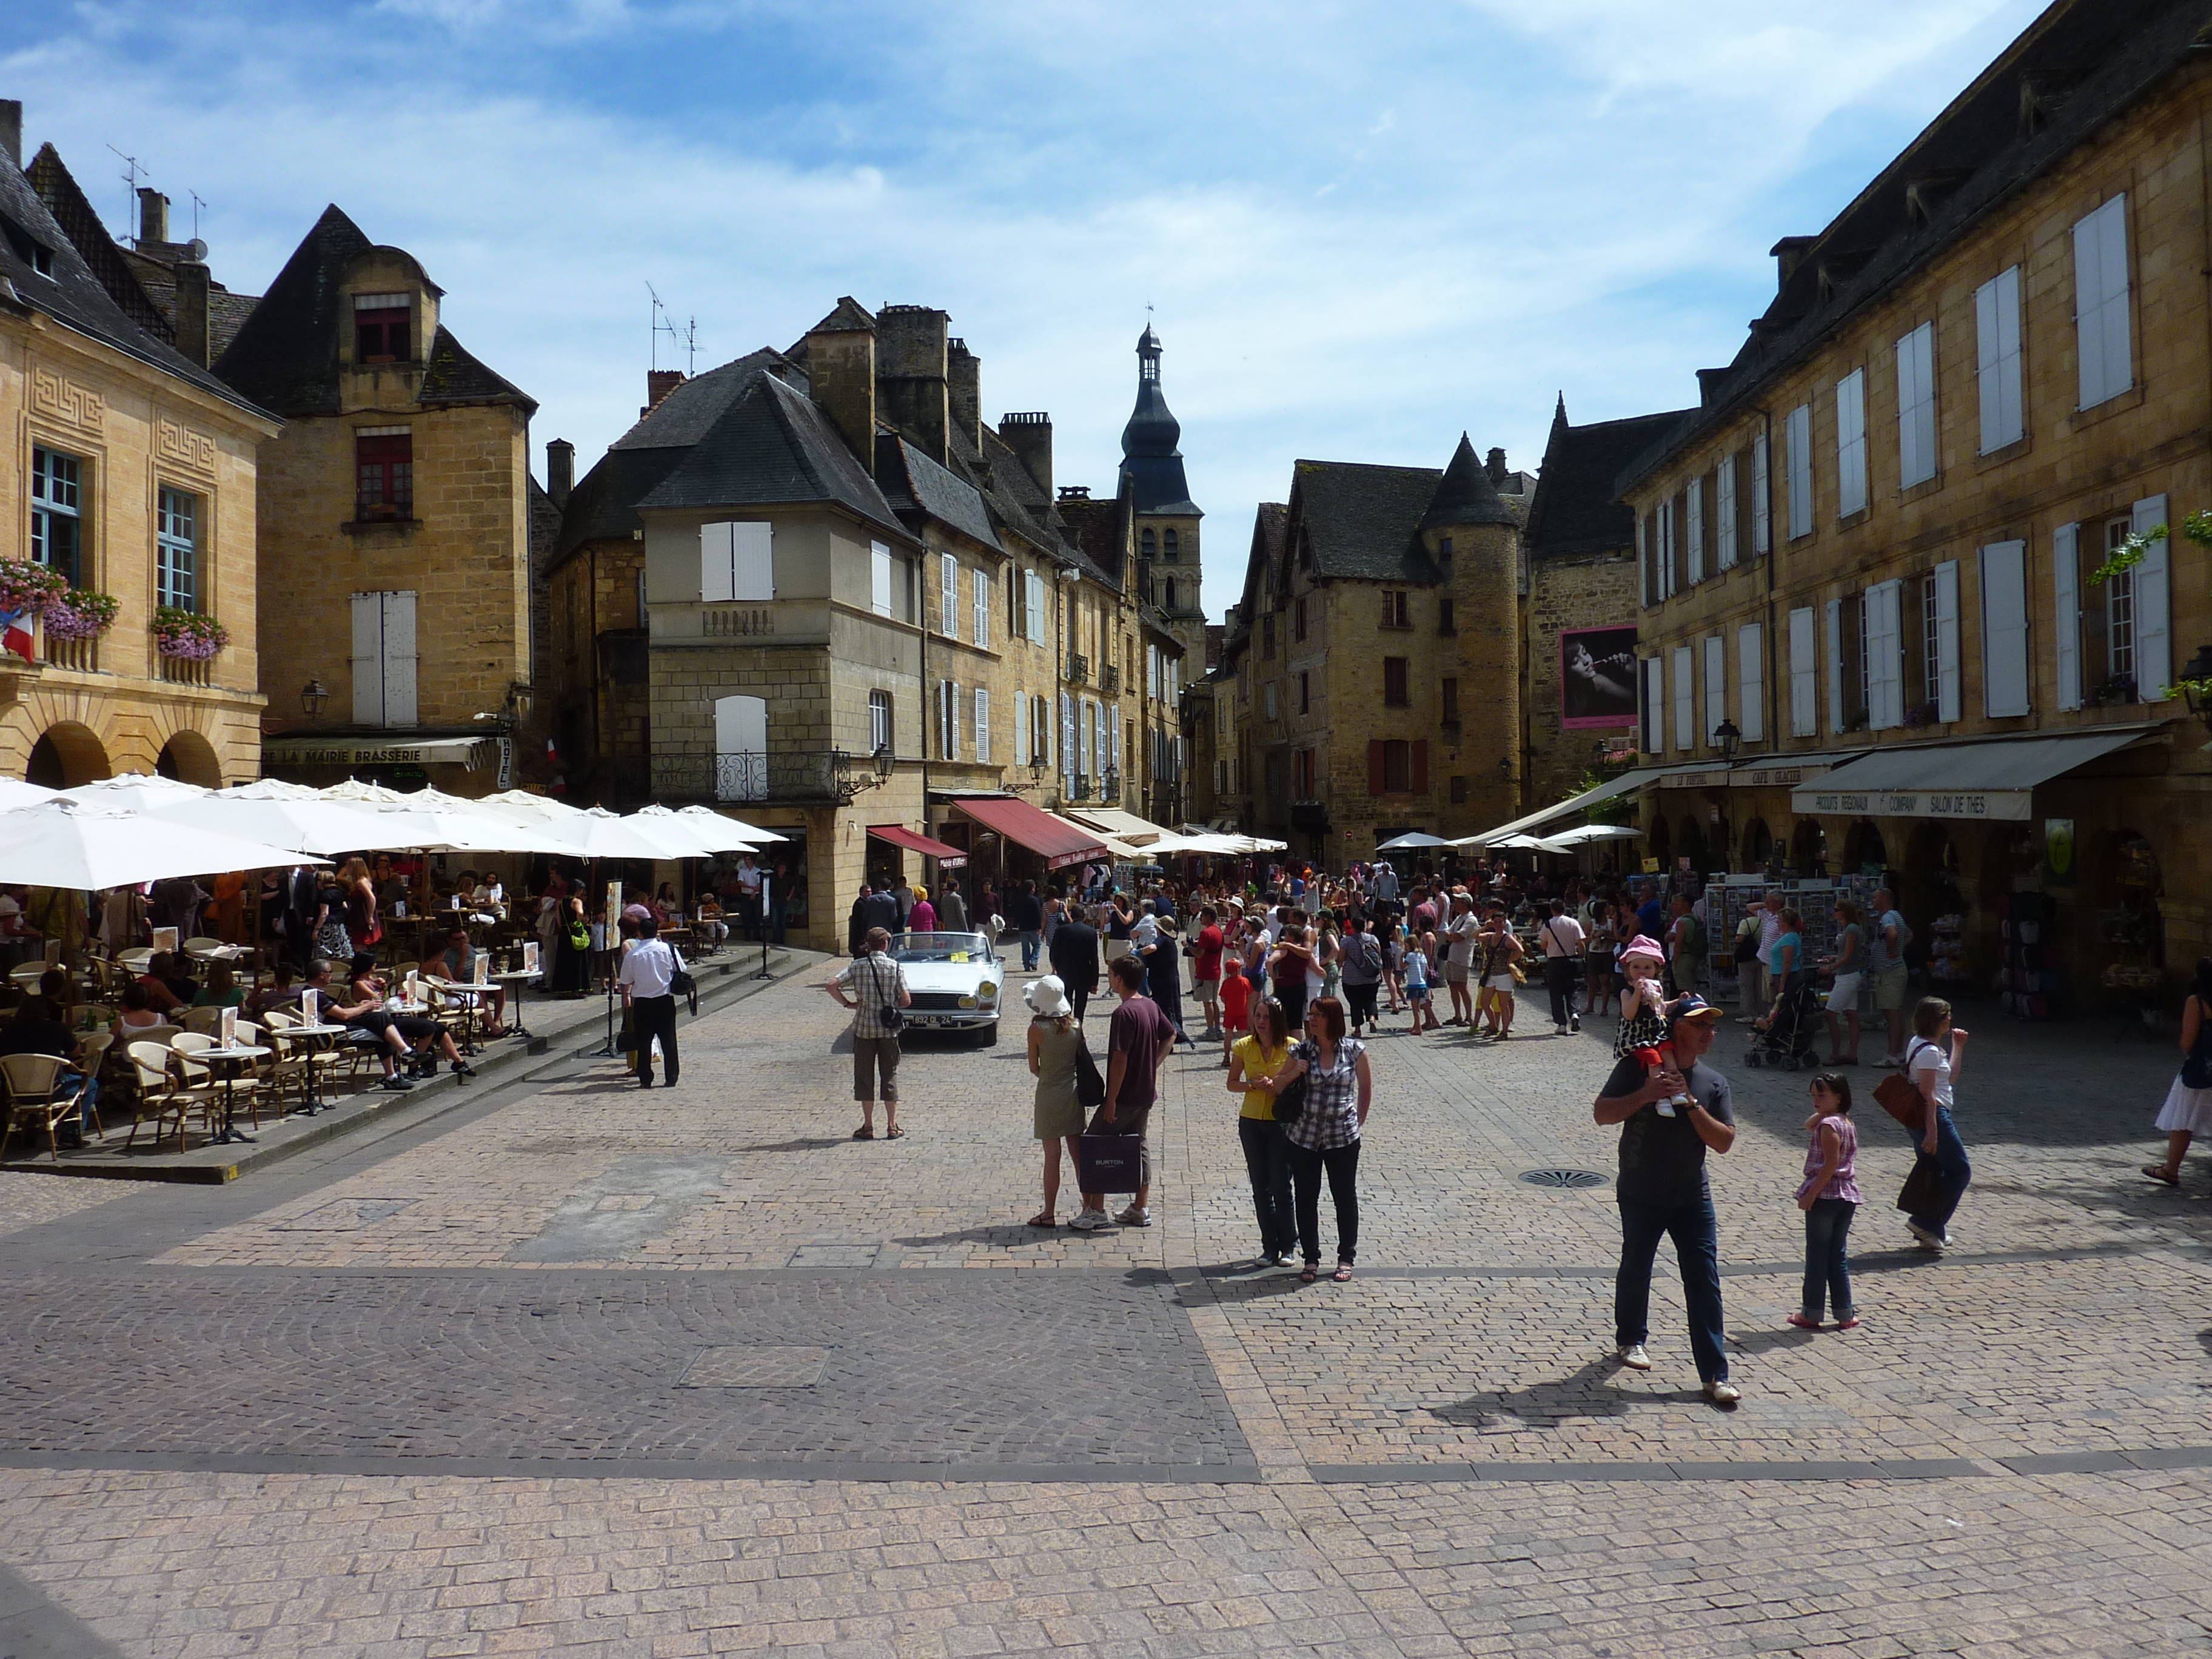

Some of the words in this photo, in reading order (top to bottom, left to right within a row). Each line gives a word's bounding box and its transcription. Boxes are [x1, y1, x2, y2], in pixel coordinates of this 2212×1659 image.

[262, 751, 275, 762] DE
[283, 751, 298, 762] LA
[306, 751, 348, 762] MAIRIE
[355, 750, 420, 762] BRASSERIE
[500, 739, 510, 783] HOTEL
[1775, 770, 1801, 783] GLACIER
[1815, 795, 1838, 811] PRODUITS
[1889, 796, 1917, 812] COMPANY
[1931, 796, 1952, 813] SALON
[1954, 796, 1964, 813] DE
[1966, 796, 1985, 814] THES
